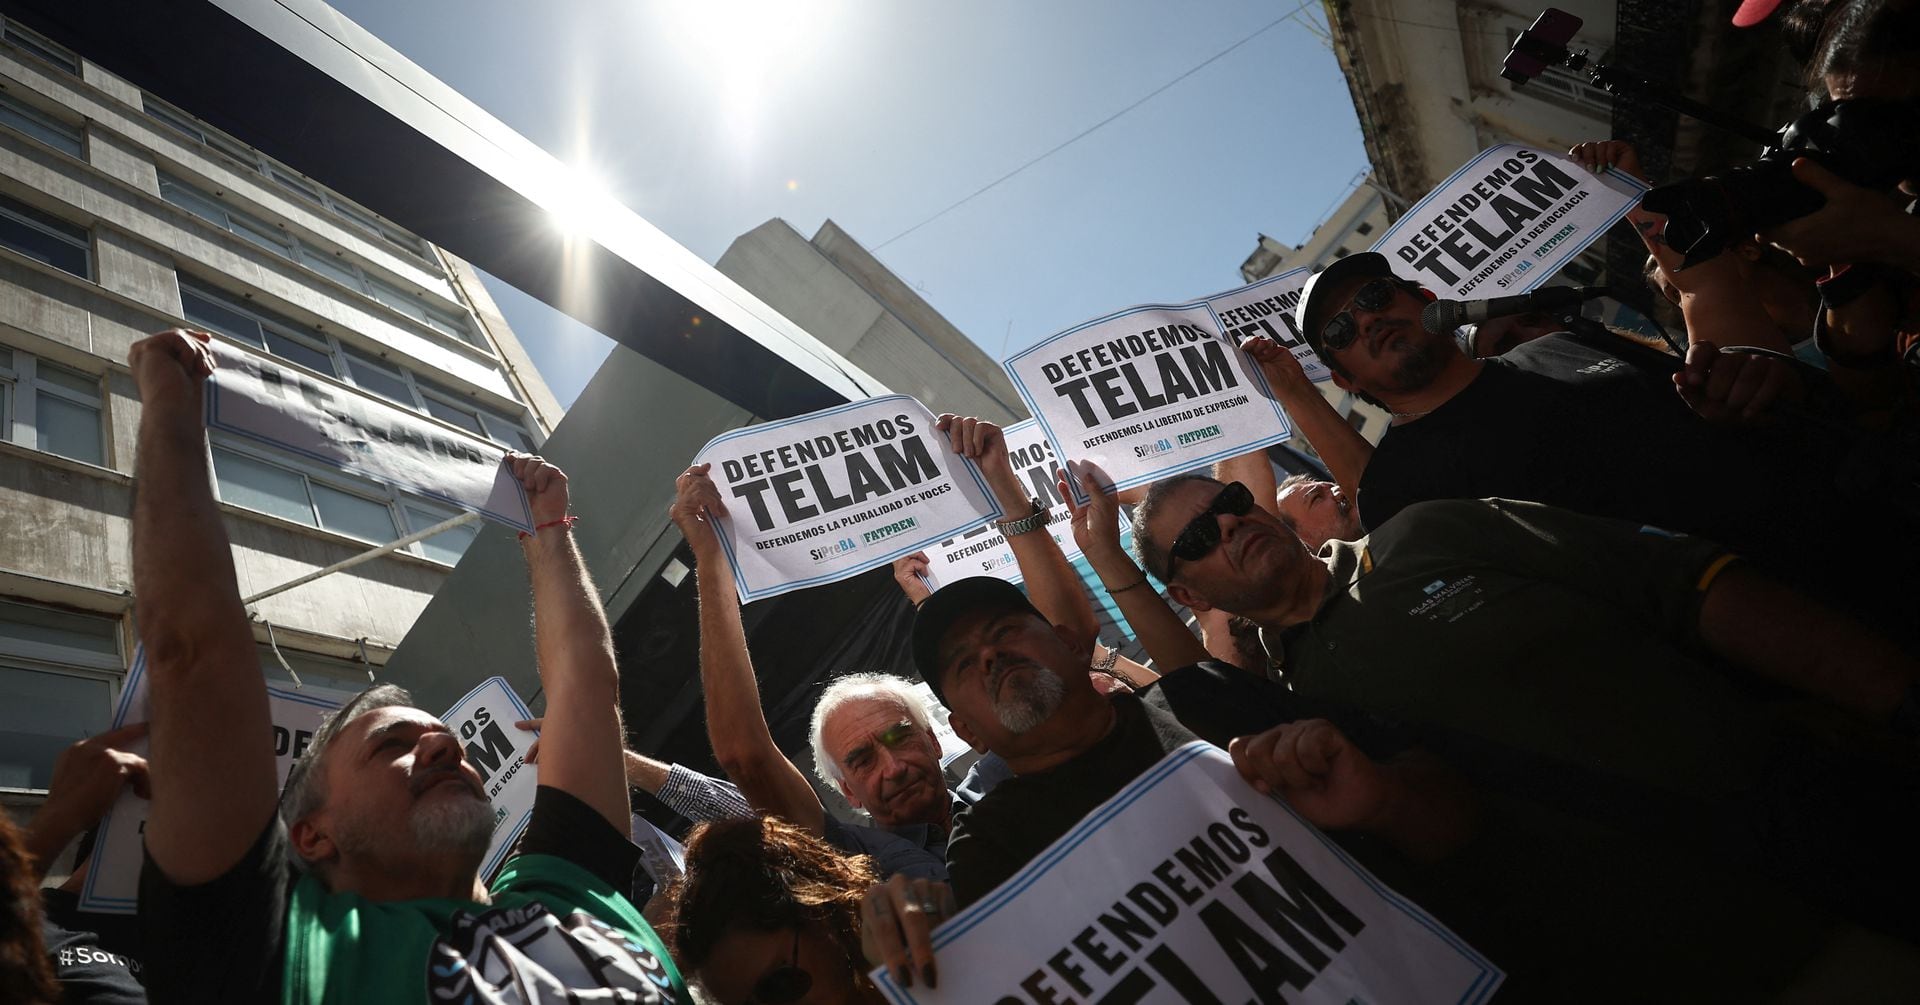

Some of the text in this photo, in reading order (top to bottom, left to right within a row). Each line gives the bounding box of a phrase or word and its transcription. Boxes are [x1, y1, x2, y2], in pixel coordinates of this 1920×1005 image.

[1397, 150, 1538, 264] DEFENDEMOS
[1413, 158, 1579, 287] TELAM
[1457, 190, 1589, 297] DEFENDEMOS LA DEMOCRACIA
[1534, 224, 1575, 257] FATPREN
[1218, 287, 1304, 328] EFENDEMO
[1041, 323, 1213, 384] DEFENDEMOS
[1054, 341, 1239, 428] TELAM
[722, 414, 915, 483] DEFENDEMOS
[1083, 395, 1249, 449] DEFENDEMOS LA LIBERTAD DE EXPRESIÓN
[1178, 425, 1220, 445] FATPREN
[731, 435, 941, 532] TELAM
[756, 483, 952, 550] DEFENDEMOS LA PLURALIDAD DE VOCES
[810, 538, 856, 561] SiPreBA
[863, 517, 916, 543] FATPREN
[946, 535, 1005, 563] DEFENDEMO
[490, 782, 502, 797] DE
[500, 756, 526, 784] VOCES
[995, 808, 1270, 1005] EFENDEMOS
